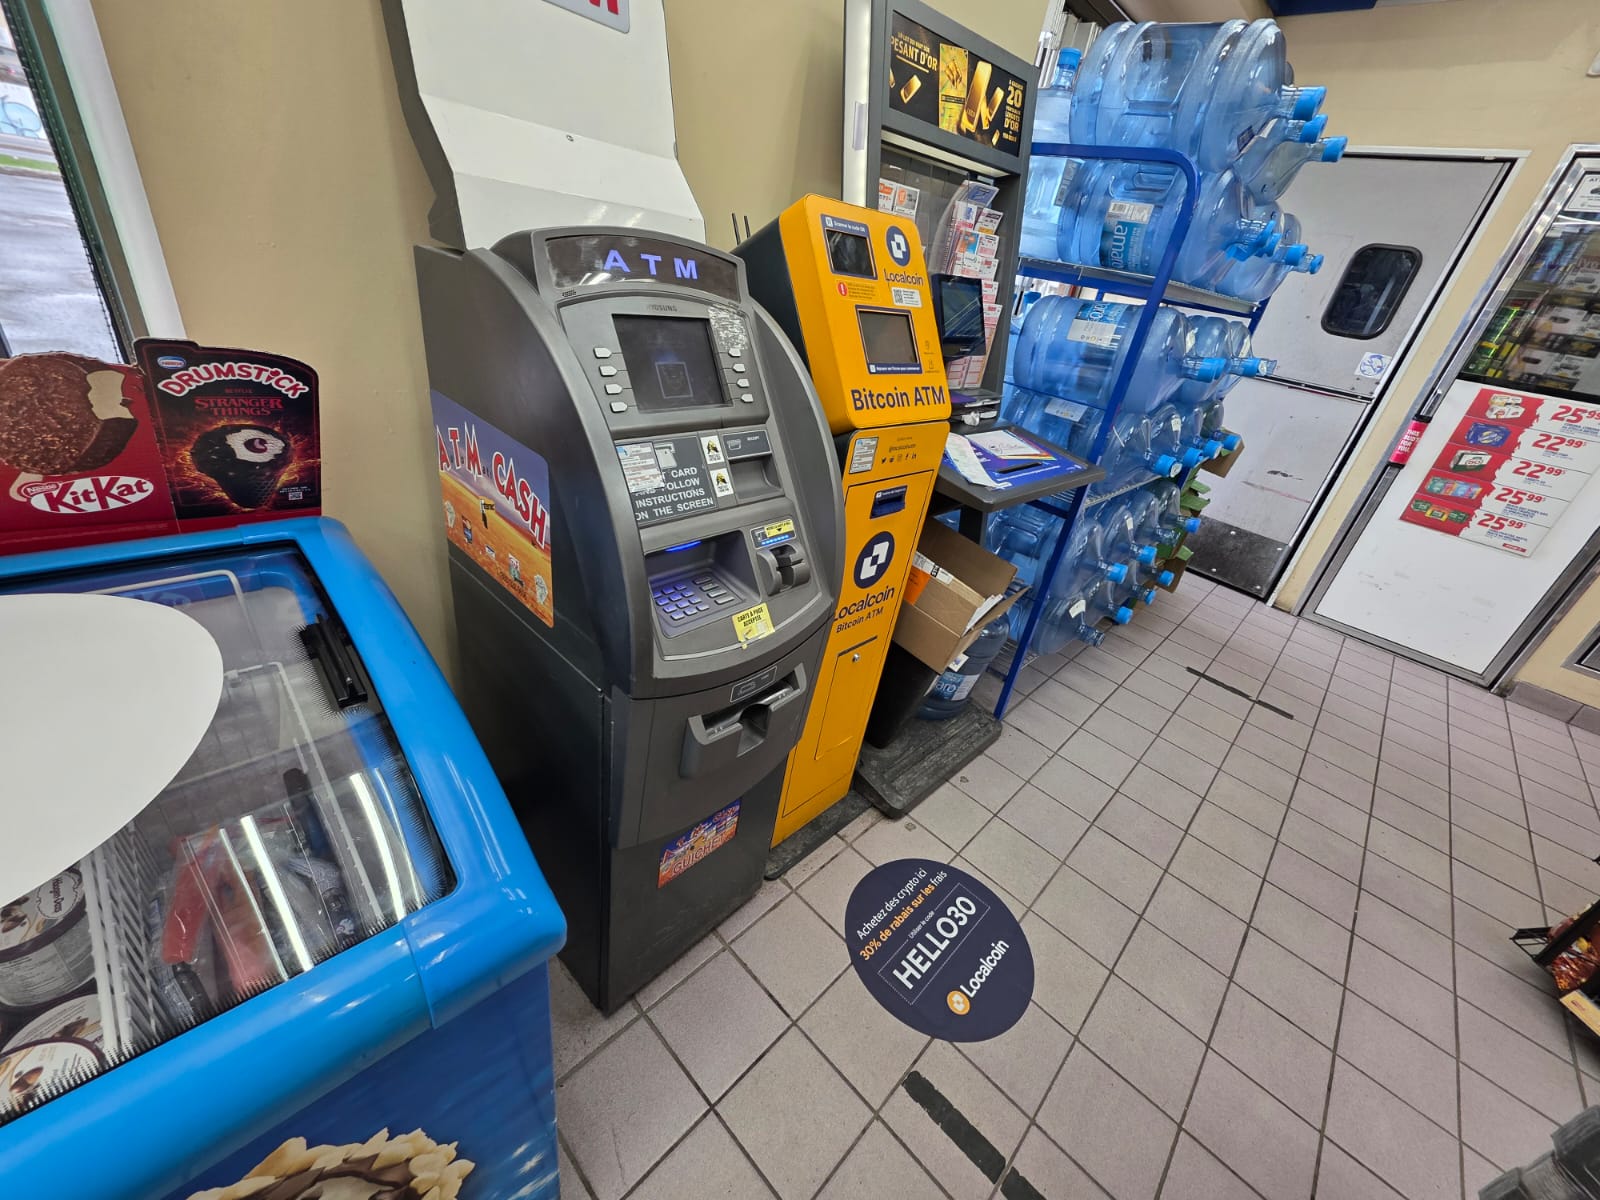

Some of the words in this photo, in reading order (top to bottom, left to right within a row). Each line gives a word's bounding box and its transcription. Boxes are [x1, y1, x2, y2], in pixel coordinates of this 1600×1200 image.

[890, 35, 920, 62] PESANT
[919, 51, 938, 71] D'OR
[1006, 85, 1023, 108] 20
[604, 249, 699, 280] ATM
[883, 267, 924, 287] Localcoin
[195, 397, 283, 409] STRANGER
[851, 386, 911, 411] Bitcoin
[914, 385, 946, 406] ATM
[212, 407, 271, 417] THINGS
[671, 466, 698, 479] CARD
[44, 477, 149, 513] KitKat
[491, 451, 549, 550] CASH
[635, 487, 706, 509] INSTRUCTIONS
[654, 506, 673, 517] THE
[677, 497, 714, 511] SCREEN
[836, 615, 864, 633] Bitcoin
[866, 606, 884, 619] ATM
[856, 908, 889, 941] Achetez
[884, 896, 900, 912] des
[897, 876, 920, 900] crypto
[914, 867, 928, 881] ici
[859, 937, 882, 961] 30%
[879, 928, 892, 941] de
[889, 905, 914, 931] rabais
[911, 893, 925, 908] sur
[919, 883, 936, 897] les
[929, 870, 948, 887] frais
[892, 896, 976, 990] HELLO30
[960, 940, 1010, 998] Localcoin
